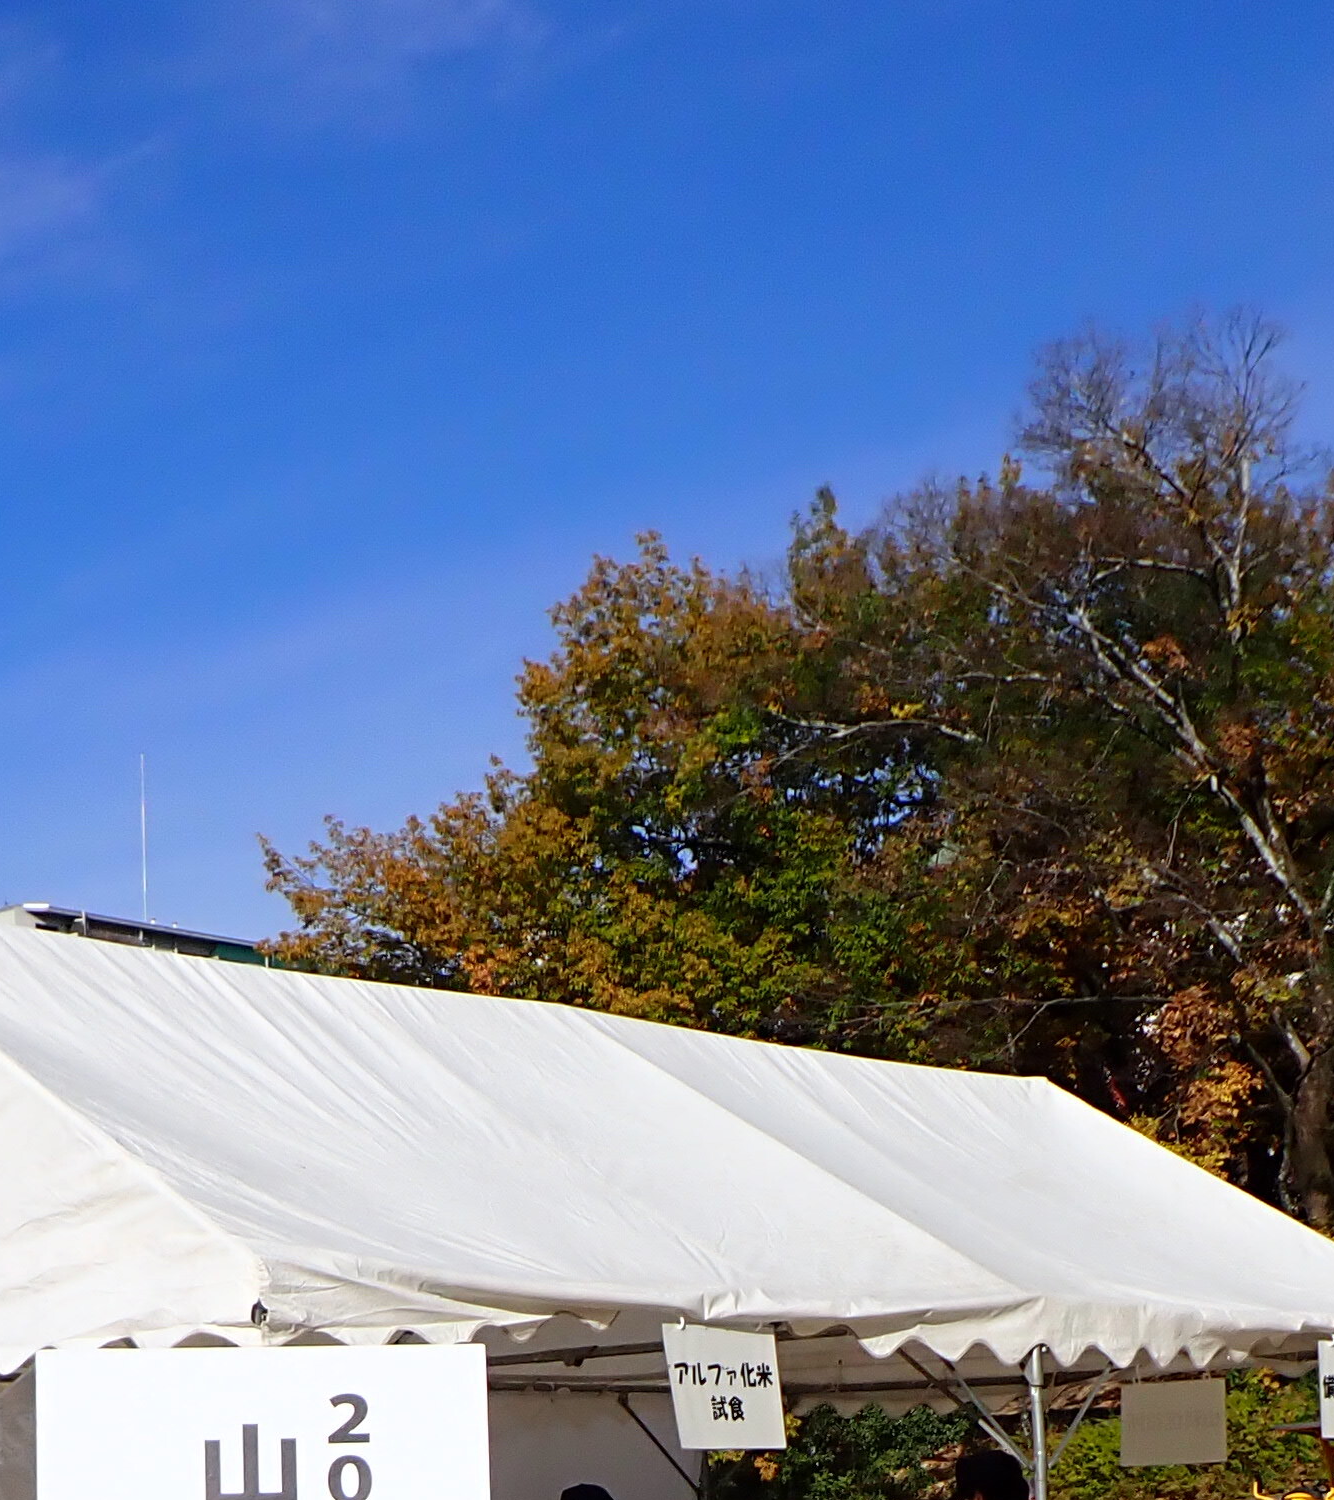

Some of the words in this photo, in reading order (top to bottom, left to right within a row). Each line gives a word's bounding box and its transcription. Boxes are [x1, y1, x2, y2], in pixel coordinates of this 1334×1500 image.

[673, 1362, 773, 1388] アルファ化米
[710, 1395, 745, 1421] 試食
